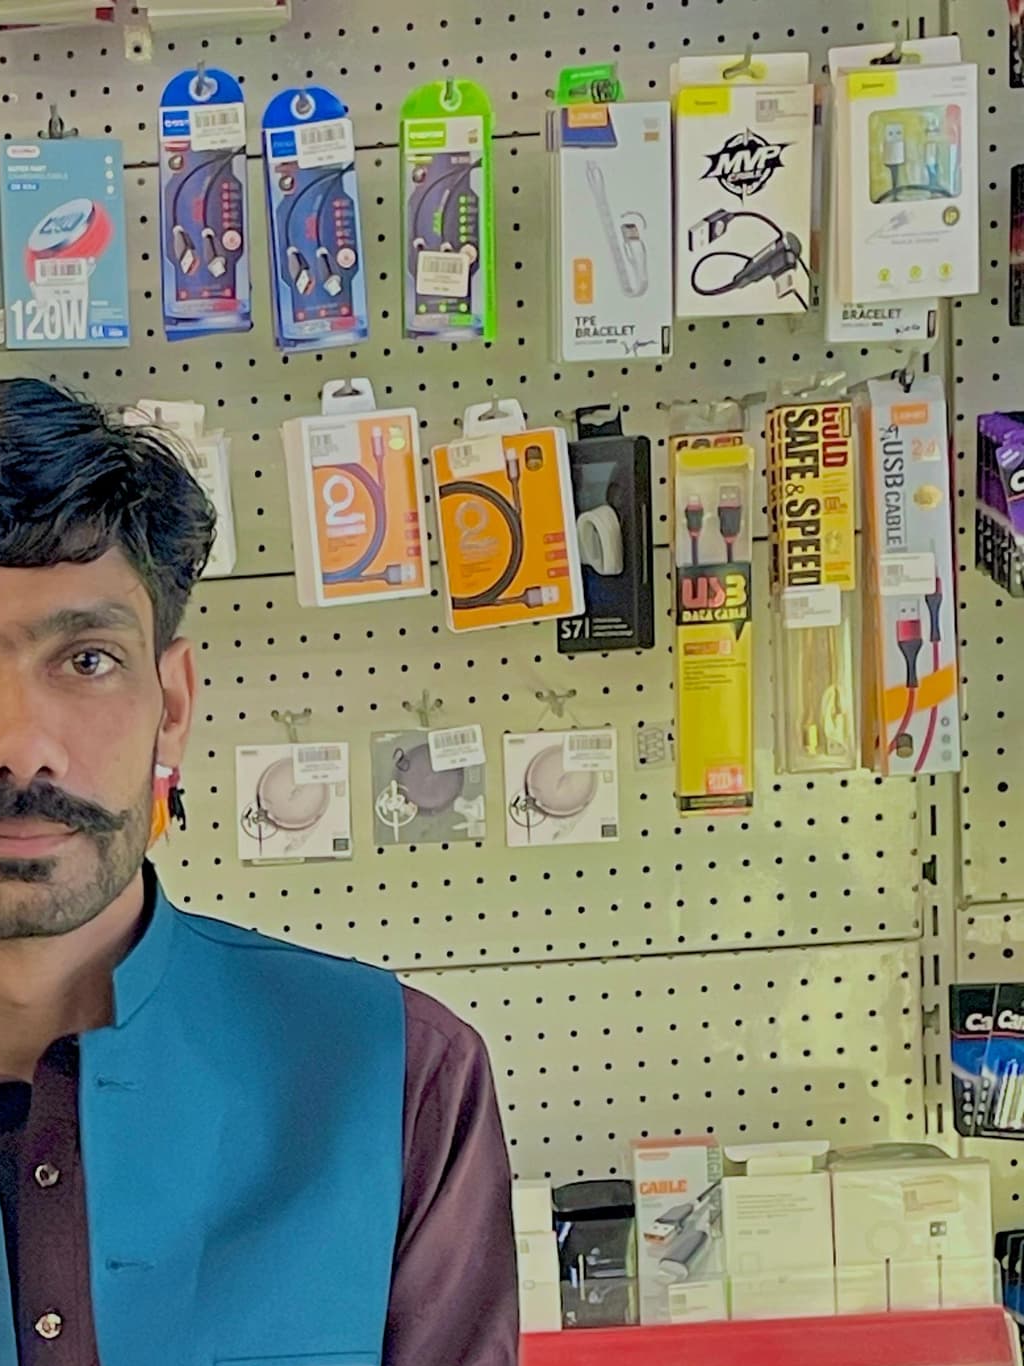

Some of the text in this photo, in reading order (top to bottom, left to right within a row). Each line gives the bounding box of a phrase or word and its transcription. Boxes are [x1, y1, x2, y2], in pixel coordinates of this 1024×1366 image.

[716, 146, 781, 176] MVP
[10, 299, 89, 341] 120W
[576, 316, 596, 327] TPE
[842, 308, 902, 321] BRACELET
[576, 324, 636, 339] BRACELET
[784, 407, 822, 588] SAFE & SPEED
[882, 440, 905, 547] USB CABLE
[561, 620, 583, 640] S7
[640, 1179, 688, 1196] CABLE
